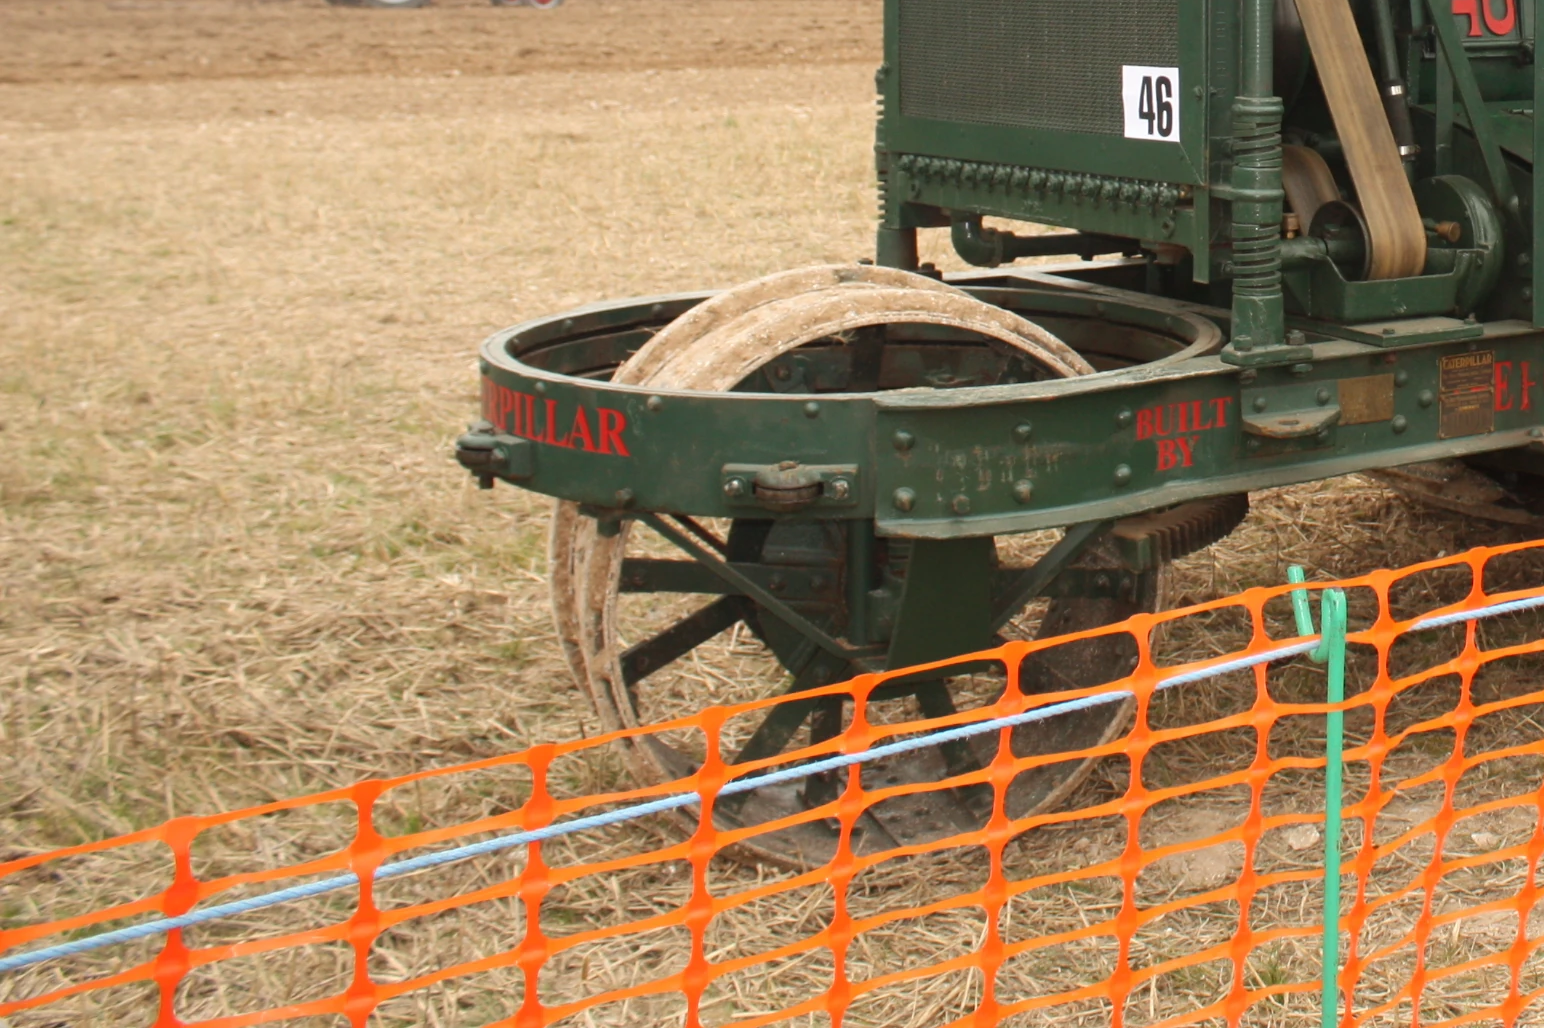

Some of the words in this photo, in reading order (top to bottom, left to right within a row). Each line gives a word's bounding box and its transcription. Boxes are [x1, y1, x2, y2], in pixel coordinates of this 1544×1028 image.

[1138, 75, 1173, 138] 46
[1135, 395, 1234, 442] BUILT
[1155, 434, 1200, 472] BY
